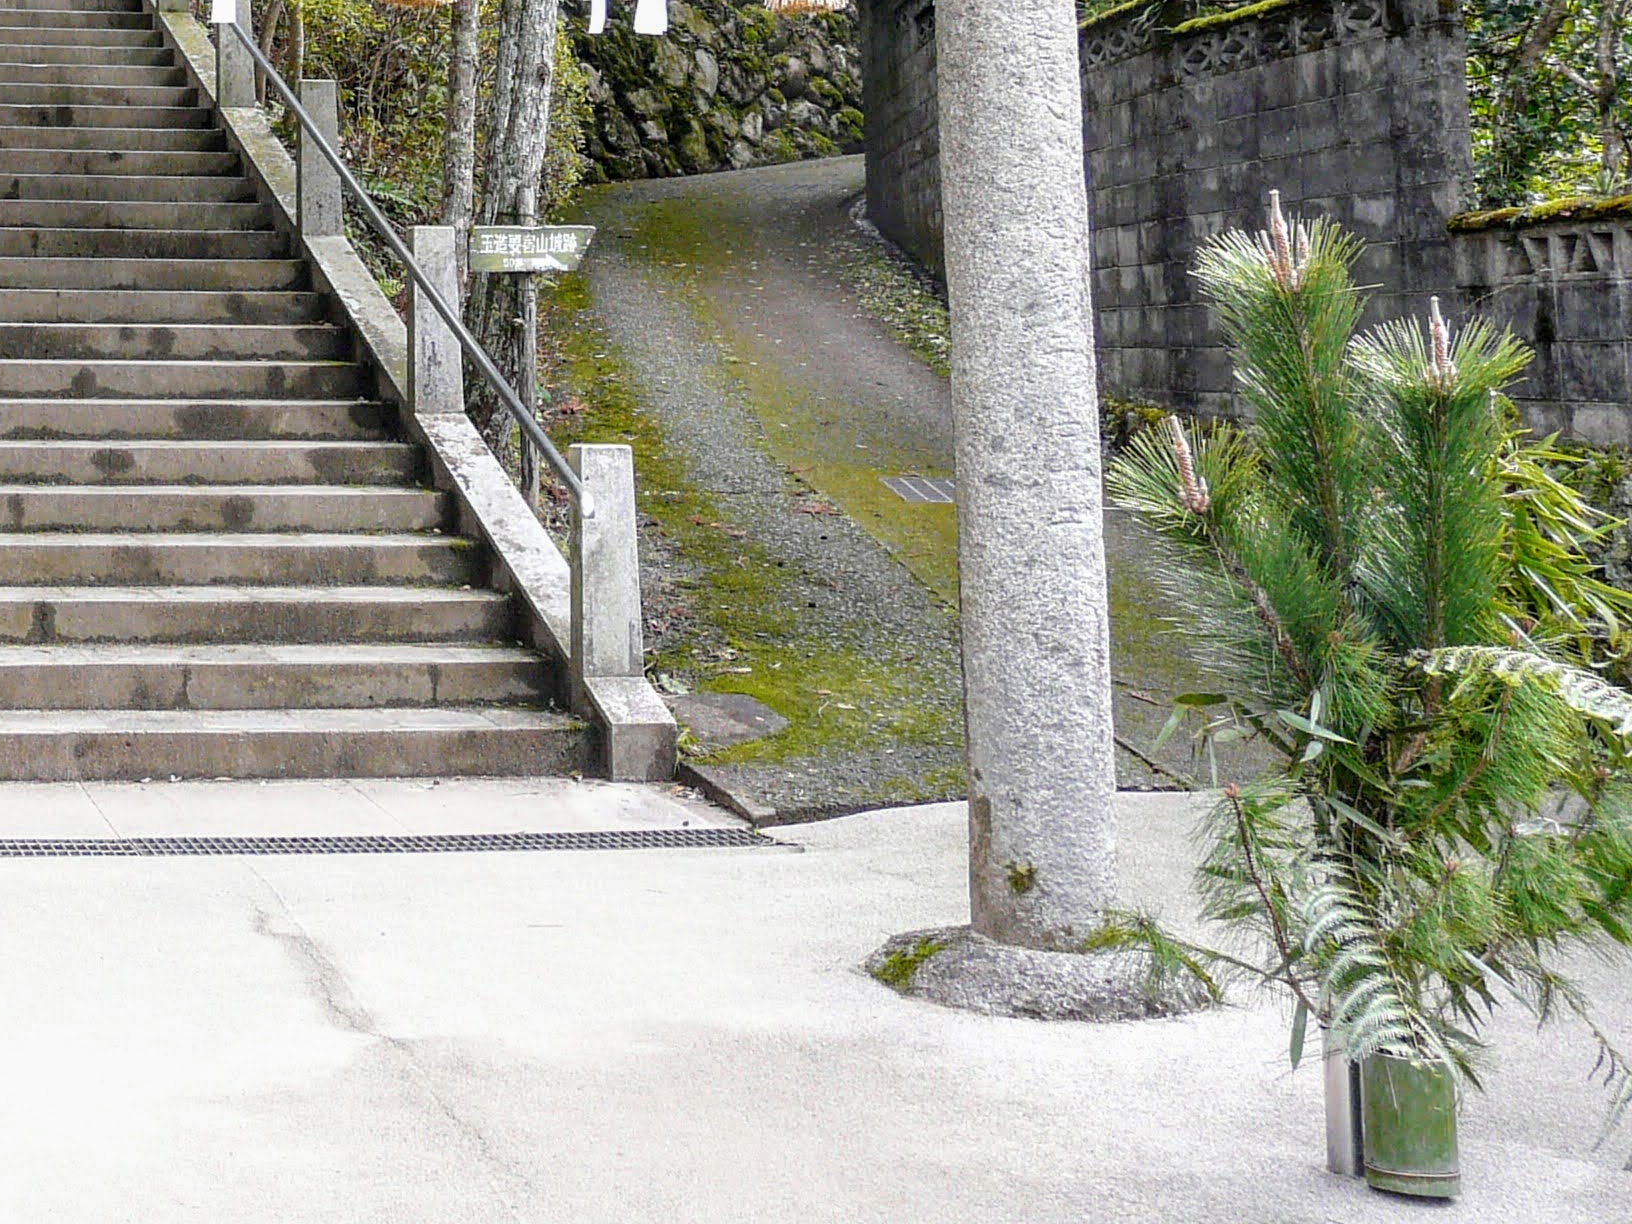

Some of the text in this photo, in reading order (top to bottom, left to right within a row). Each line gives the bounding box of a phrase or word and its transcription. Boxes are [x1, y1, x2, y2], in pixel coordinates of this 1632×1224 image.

[480, 233, 577, 255] 玉造要害山城跡
